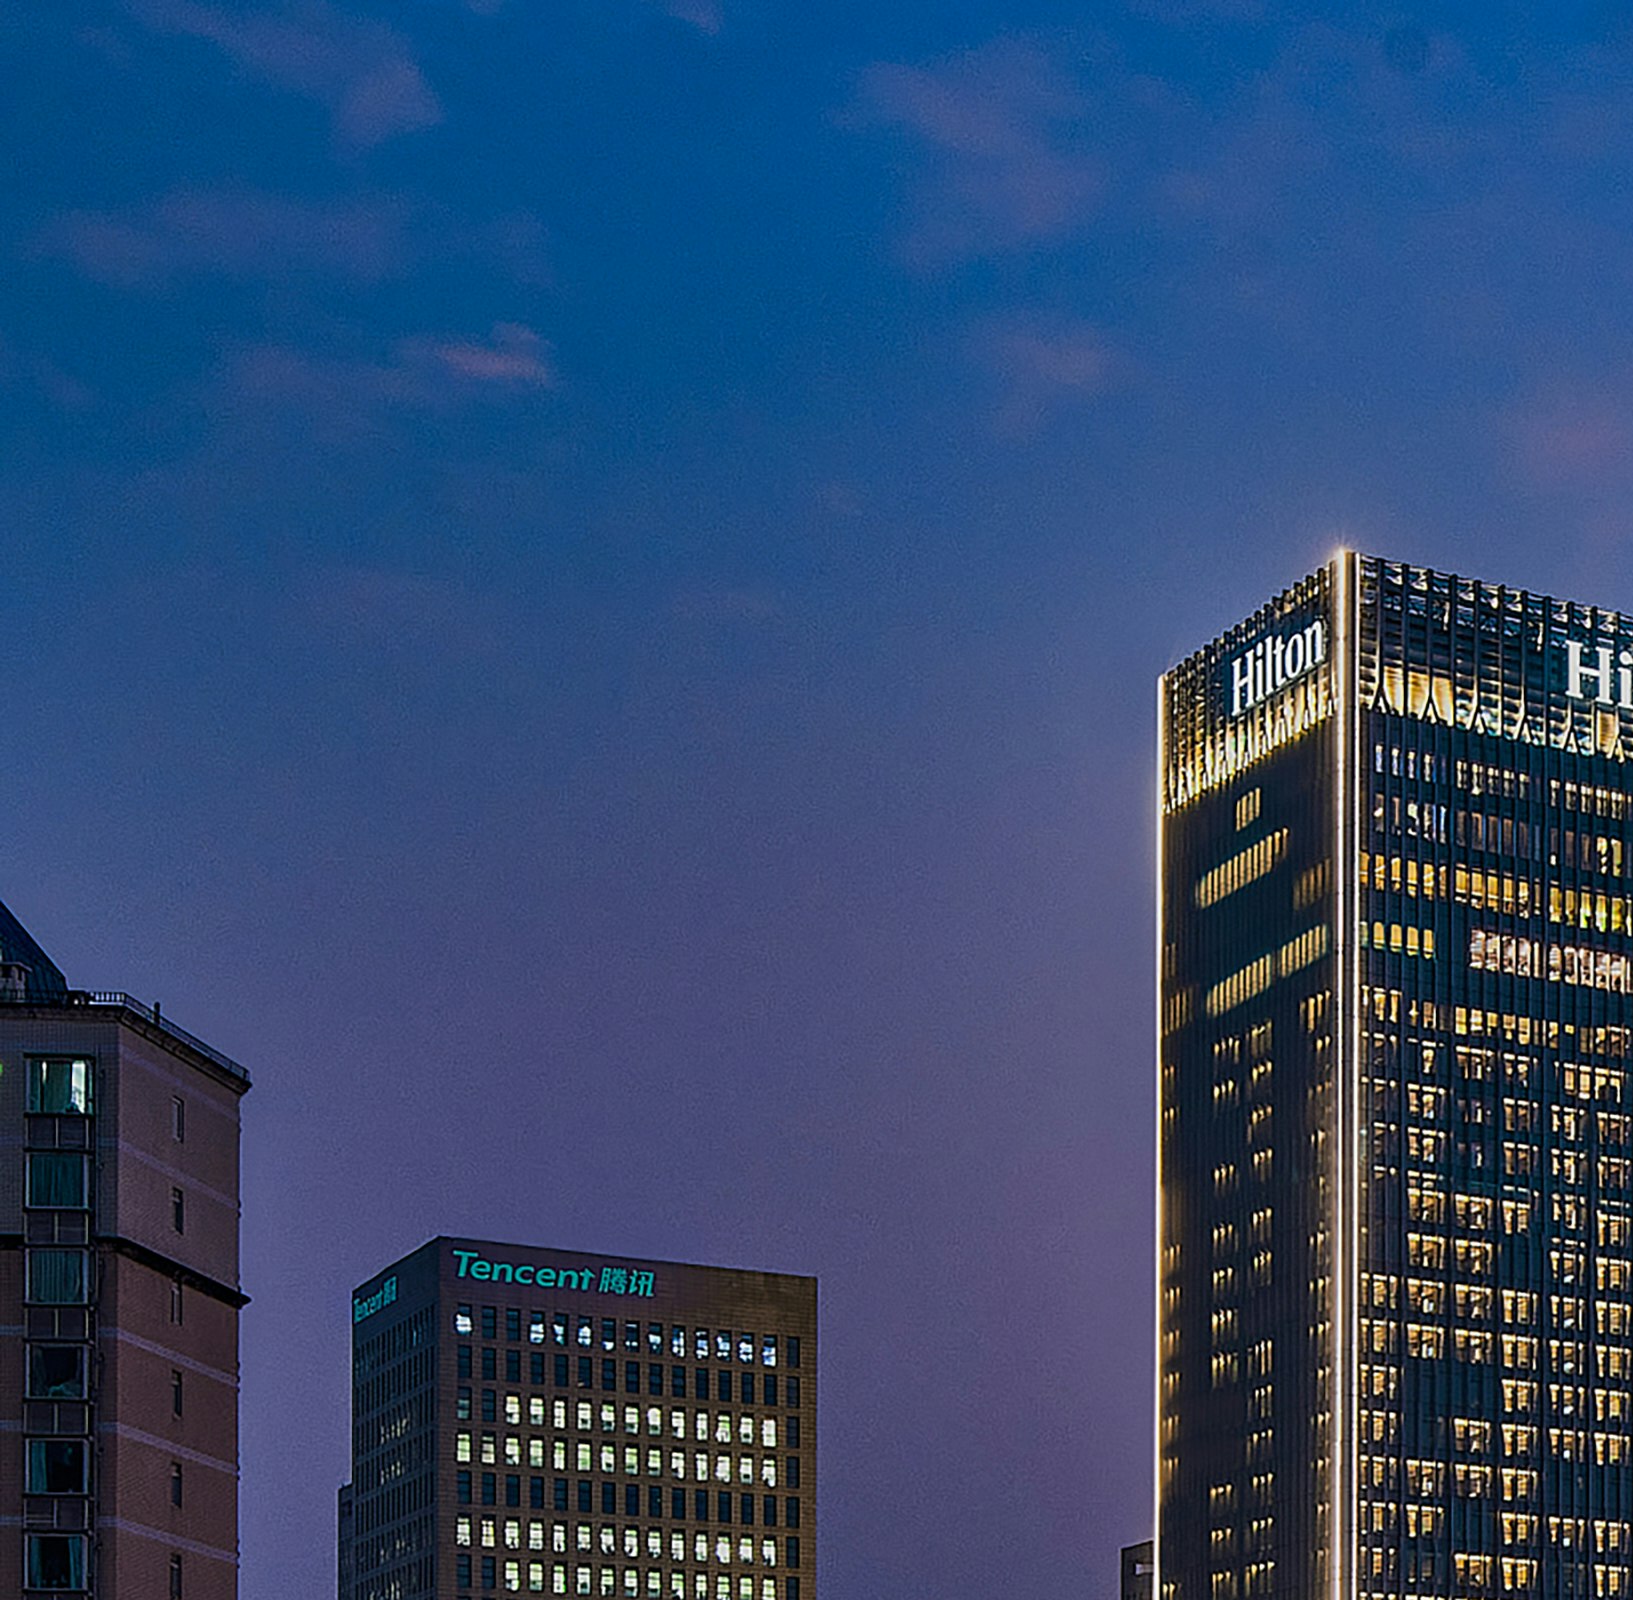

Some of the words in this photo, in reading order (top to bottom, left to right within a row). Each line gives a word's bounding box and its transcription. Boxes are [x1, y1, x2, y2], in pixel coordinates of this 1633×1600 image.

[1231, 618, 1325, 718] Hilton
[453, 1250, 596, 1292] Tencent
[599, 1267, 656, 1298] 腾讯
